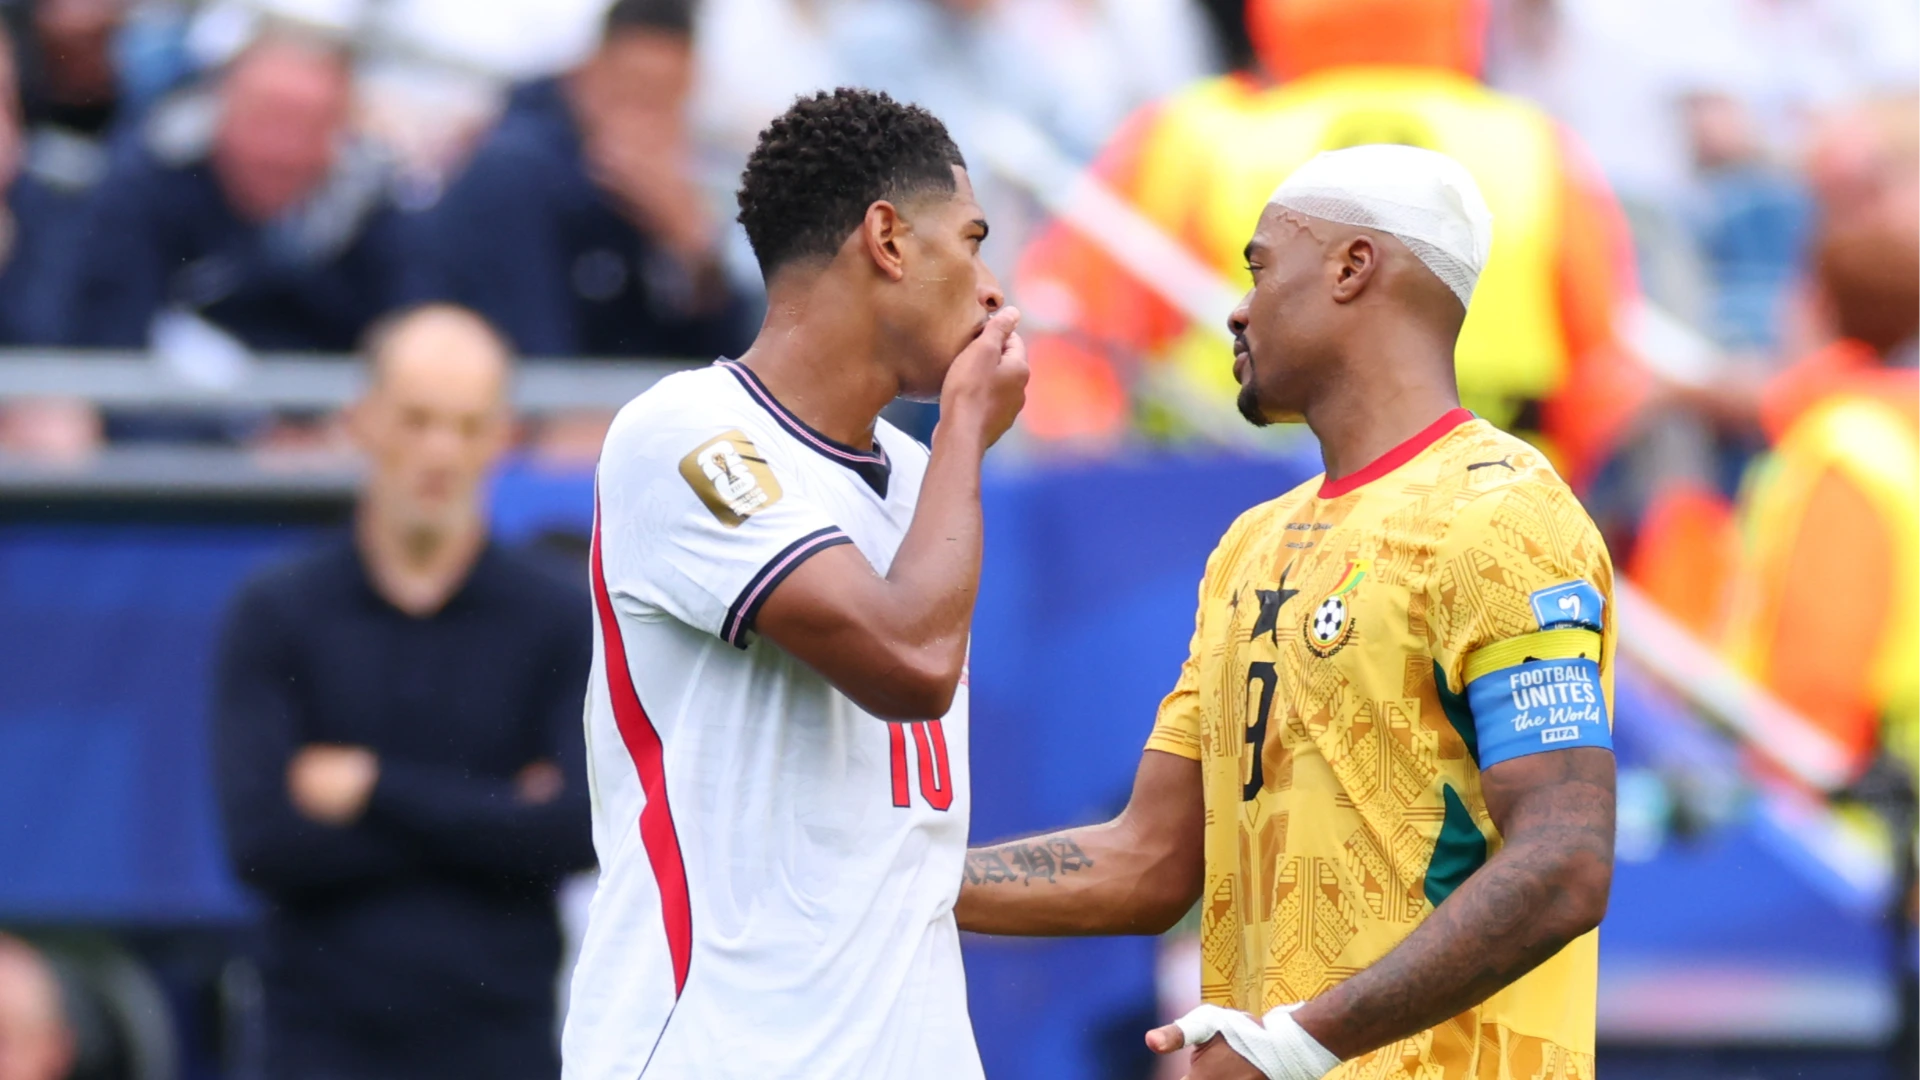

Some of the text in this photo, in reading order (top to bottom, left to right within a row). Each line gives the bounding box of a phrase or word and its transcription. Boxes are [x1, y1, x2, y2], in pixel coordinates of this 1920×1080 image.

[1510, 666, 1592, 689] FOOTBALL
[1512, 682, 1596, 711] UNITES
[1242, 661, 1278, 802] 9
[1511, 704, 1600, 731] the World
[1543, 727, 1578, 742] FIFA
[887, 718, 953, 812] 10
